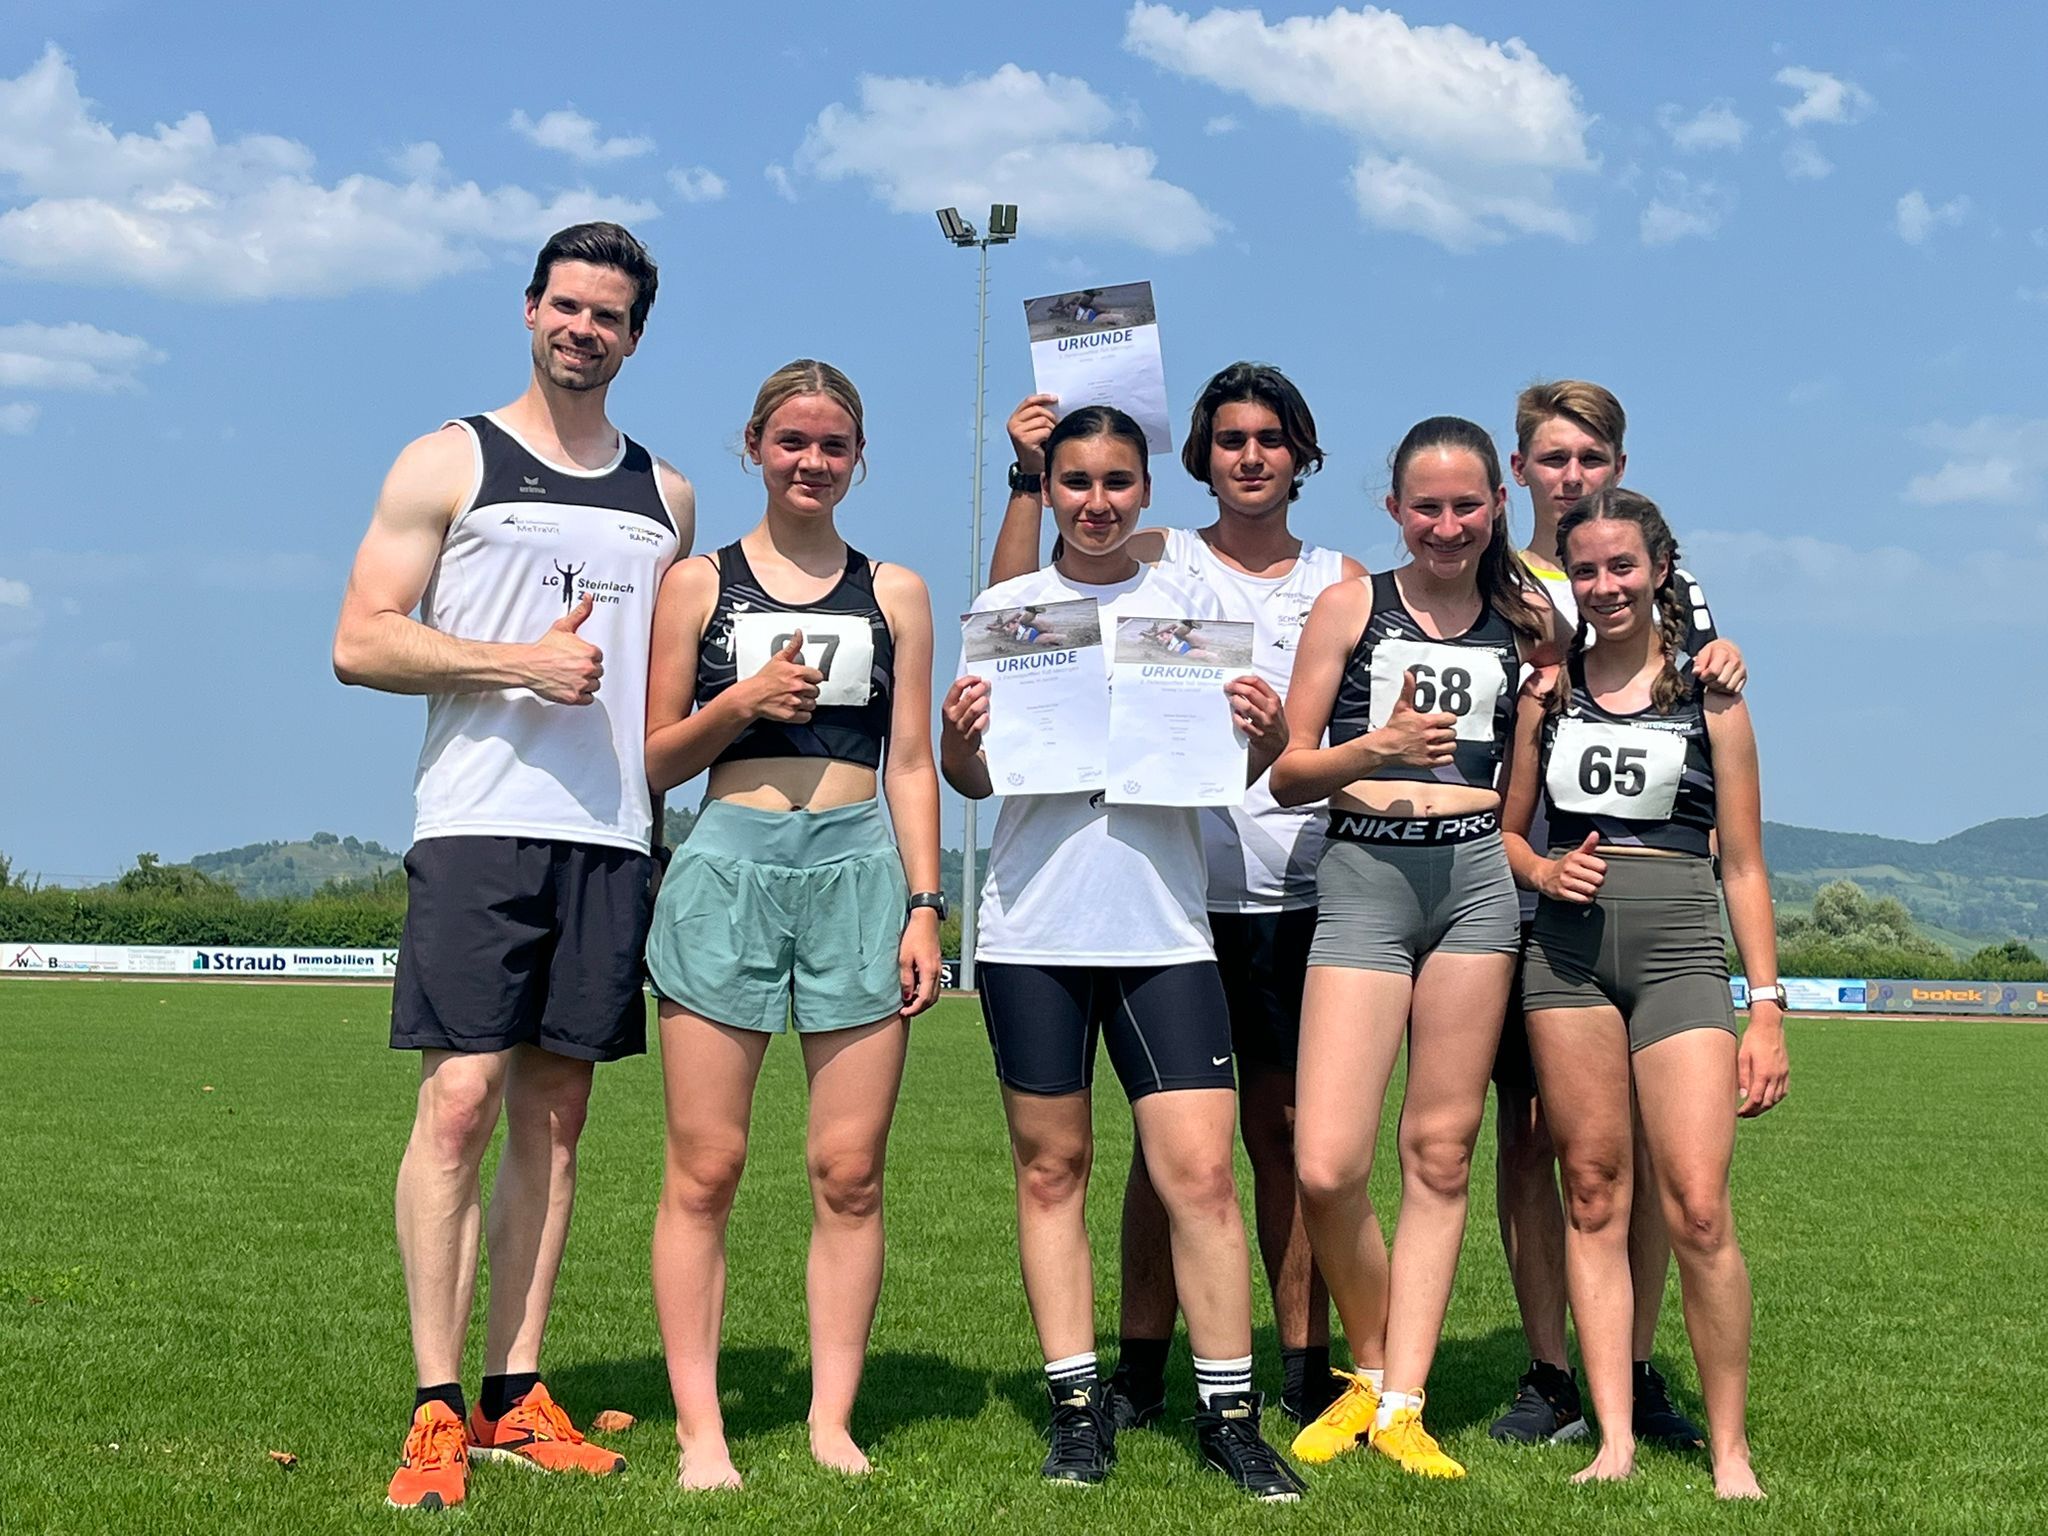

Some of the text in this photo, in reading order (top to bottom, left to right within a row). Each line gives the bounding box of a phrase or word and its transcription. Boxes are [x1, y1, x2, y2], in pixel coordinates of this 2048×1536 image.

[1058, 329, 1133, 351] URKUNDE
[542, 576, 634, 593] LG Steinlach
[577, 591, 620, 604] Zllern
[996, 650, 1078, 673] URKUNDE
[1141, 665, 1225, 680] URKUNDE
[1406, 663, 1472, 717] 68
[1578, 744, 1648, 797] 65
[1338, 816, 1429, 841] NIKE
[213, 952, 286, 971] Straub
[293, 953, 374, 966] Immobilien
[1911, 987, 1983, 1001] botek
